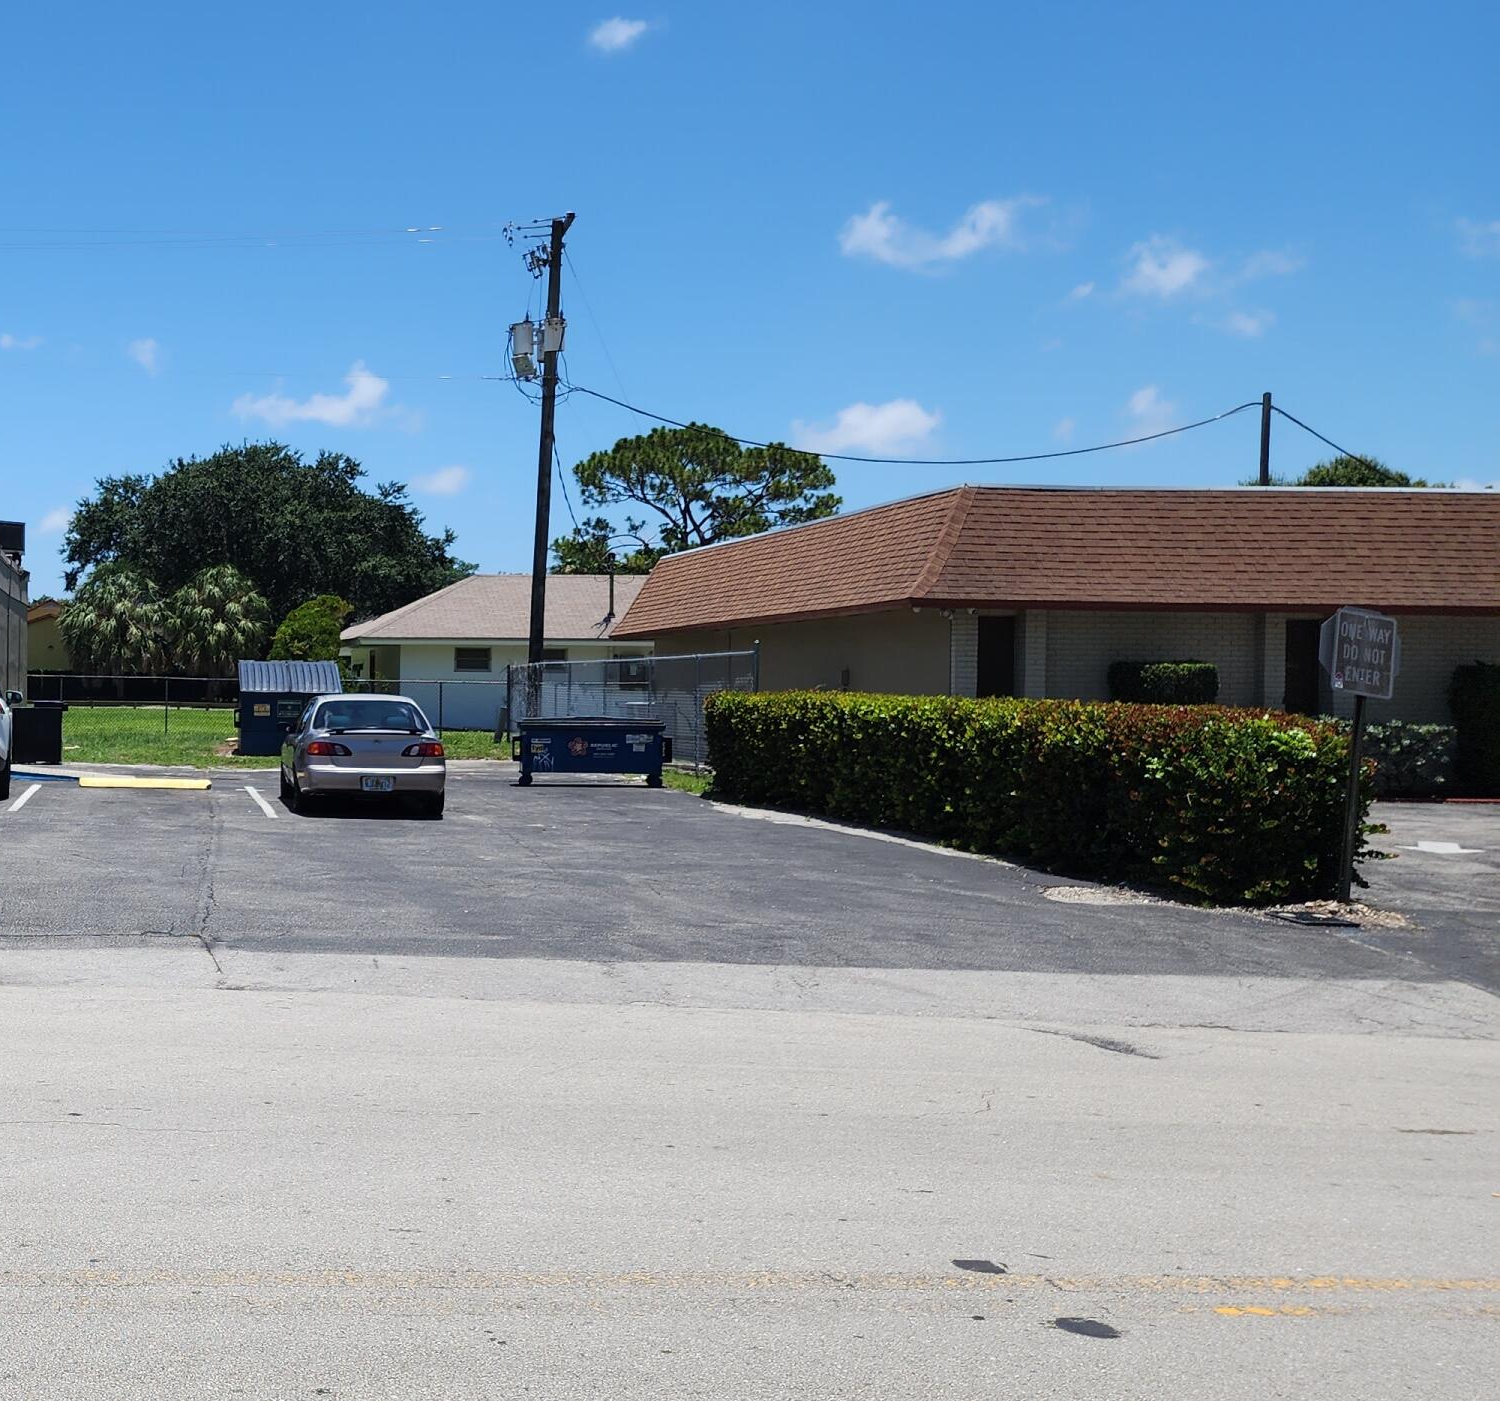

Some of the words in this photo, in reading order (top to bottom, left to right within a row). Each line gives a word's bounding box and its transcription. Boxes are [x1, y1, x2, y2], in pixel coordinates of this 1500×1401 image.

[1341, 622, 1363, 640] ONE
[1368, 626, 1391, 645] WAY
[1343, 643, 1359, 661] DO
[1364, 647, 1386, 666] NOT
[1345, 666, 1380, 686] ENTER
